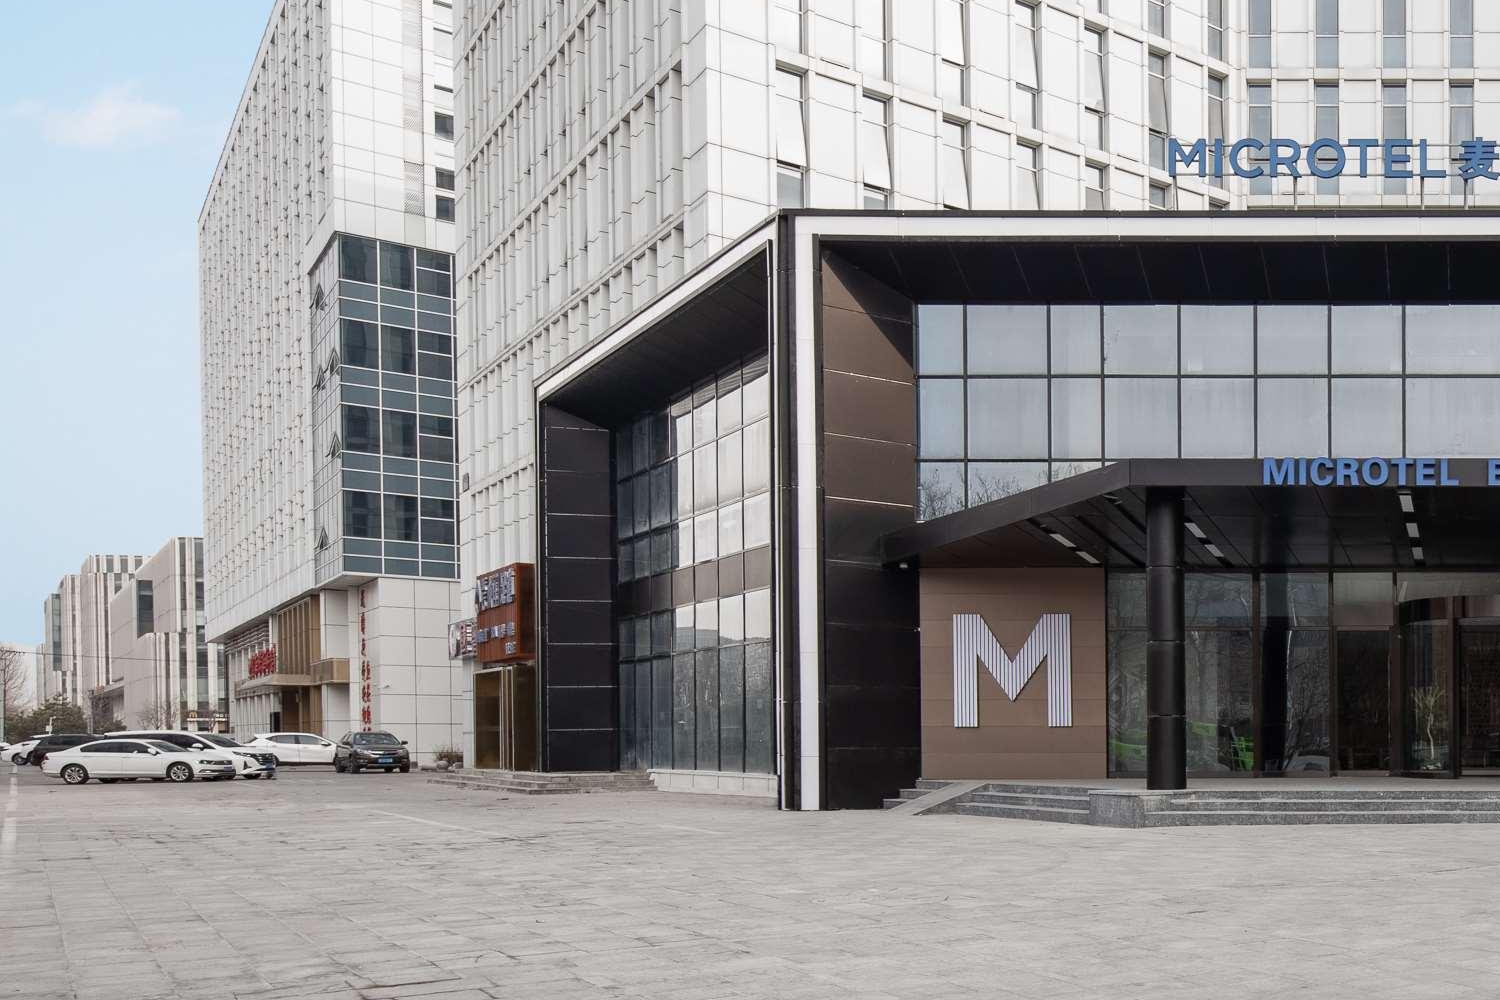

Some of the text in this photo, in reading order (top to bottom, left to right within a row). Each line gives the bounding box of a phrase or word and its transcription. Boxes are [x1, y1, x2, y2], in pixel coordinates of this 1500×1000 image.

[1168, 137, 1447, 179] MICROTEL
[1262, 457, 1460, 487] MICROTEL
[953, 613, 1072, 728] M
